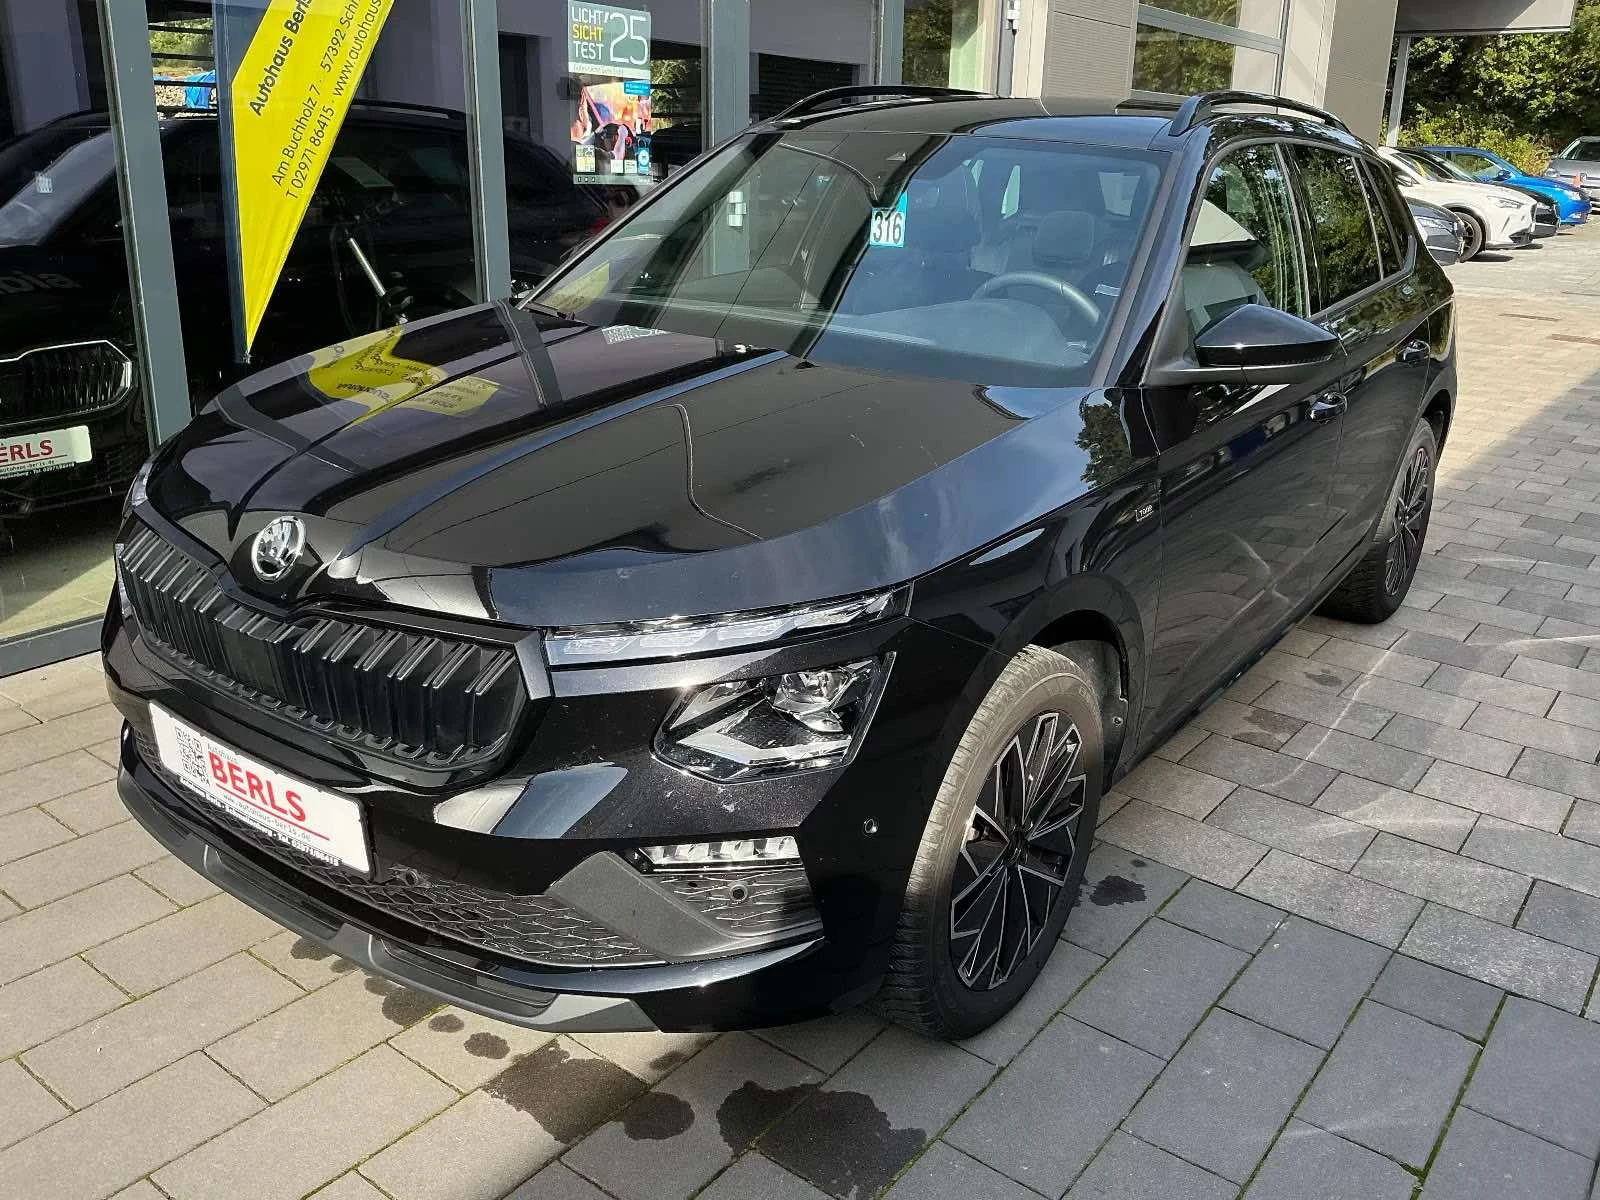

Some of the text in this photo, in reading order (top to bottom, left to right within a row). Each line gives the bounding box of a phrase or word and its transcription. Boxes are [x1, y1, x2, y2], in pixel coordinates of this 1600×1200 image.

[571, 6, 604, 25] LICHT
[571, 23, 604, 42] SICHT
[572, 40, 604, 61] TEST
[249, 35, 293, 116] Autohaus
[272, 160, 290, 187] Am
[282, 96, 318, 159] Buchholz
[309, 83, 321, 96] 7
[320, 28, 347, 73] 57392
[309, 105, 335, 147] 86415
[291, 148, 318, 189] 02971
[286, 188, 299, 200] T
[873, 211, 903, 245] 316
[208, 750, 306, 822] BERLS
